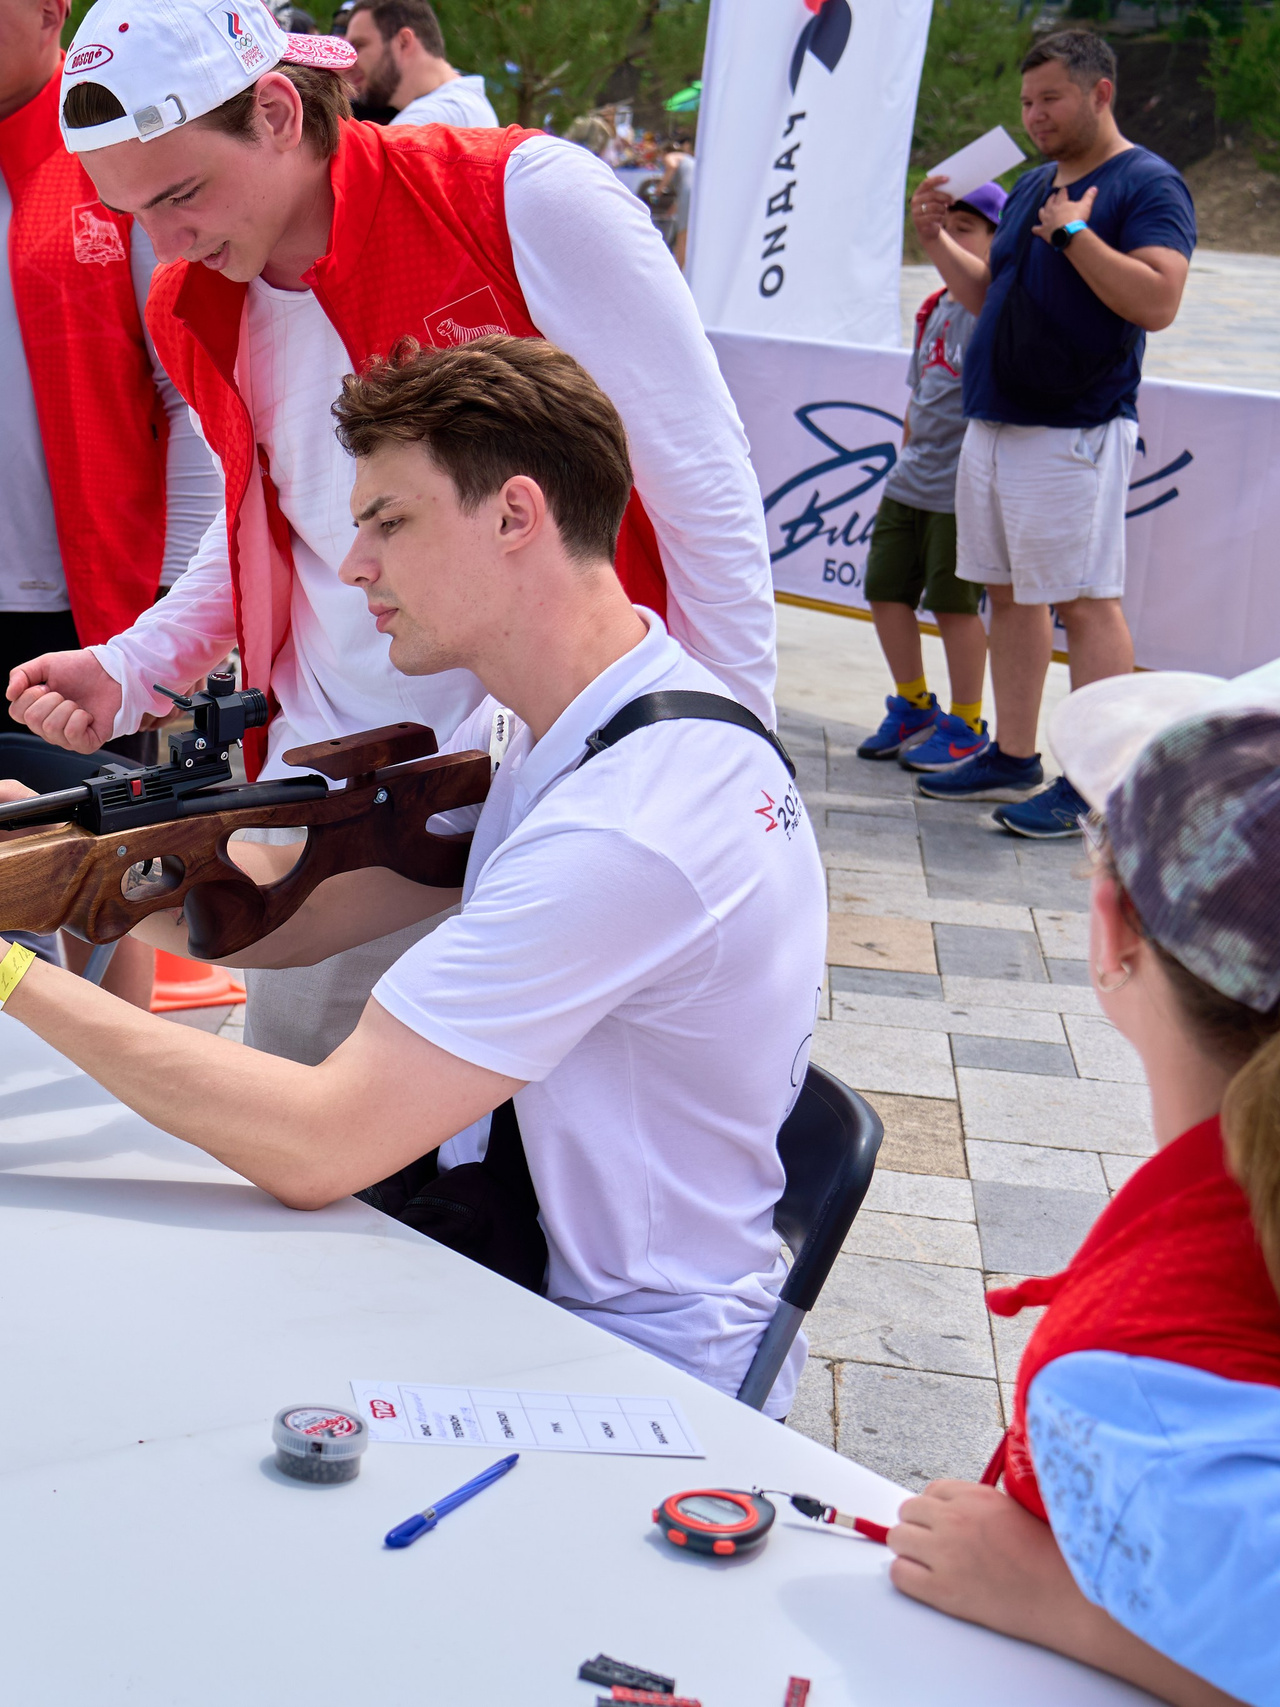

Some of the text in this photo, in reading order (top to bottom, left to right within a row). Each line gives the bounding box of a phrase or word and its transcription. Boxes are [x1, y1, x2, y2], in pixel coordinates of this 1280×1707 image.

[72, 51, 94, 69] BOSCO
[371, 1400, 396, 1418] ТИР
[420, 1423, 432, 1437] ФИО
[449, 1414, 465, 1438] ТЕЛЕФОН
[496, 1410, 515, 1439] ПЭЙНТБОЛ
[649, 1420, 669, 1445] БИАТЛОН
